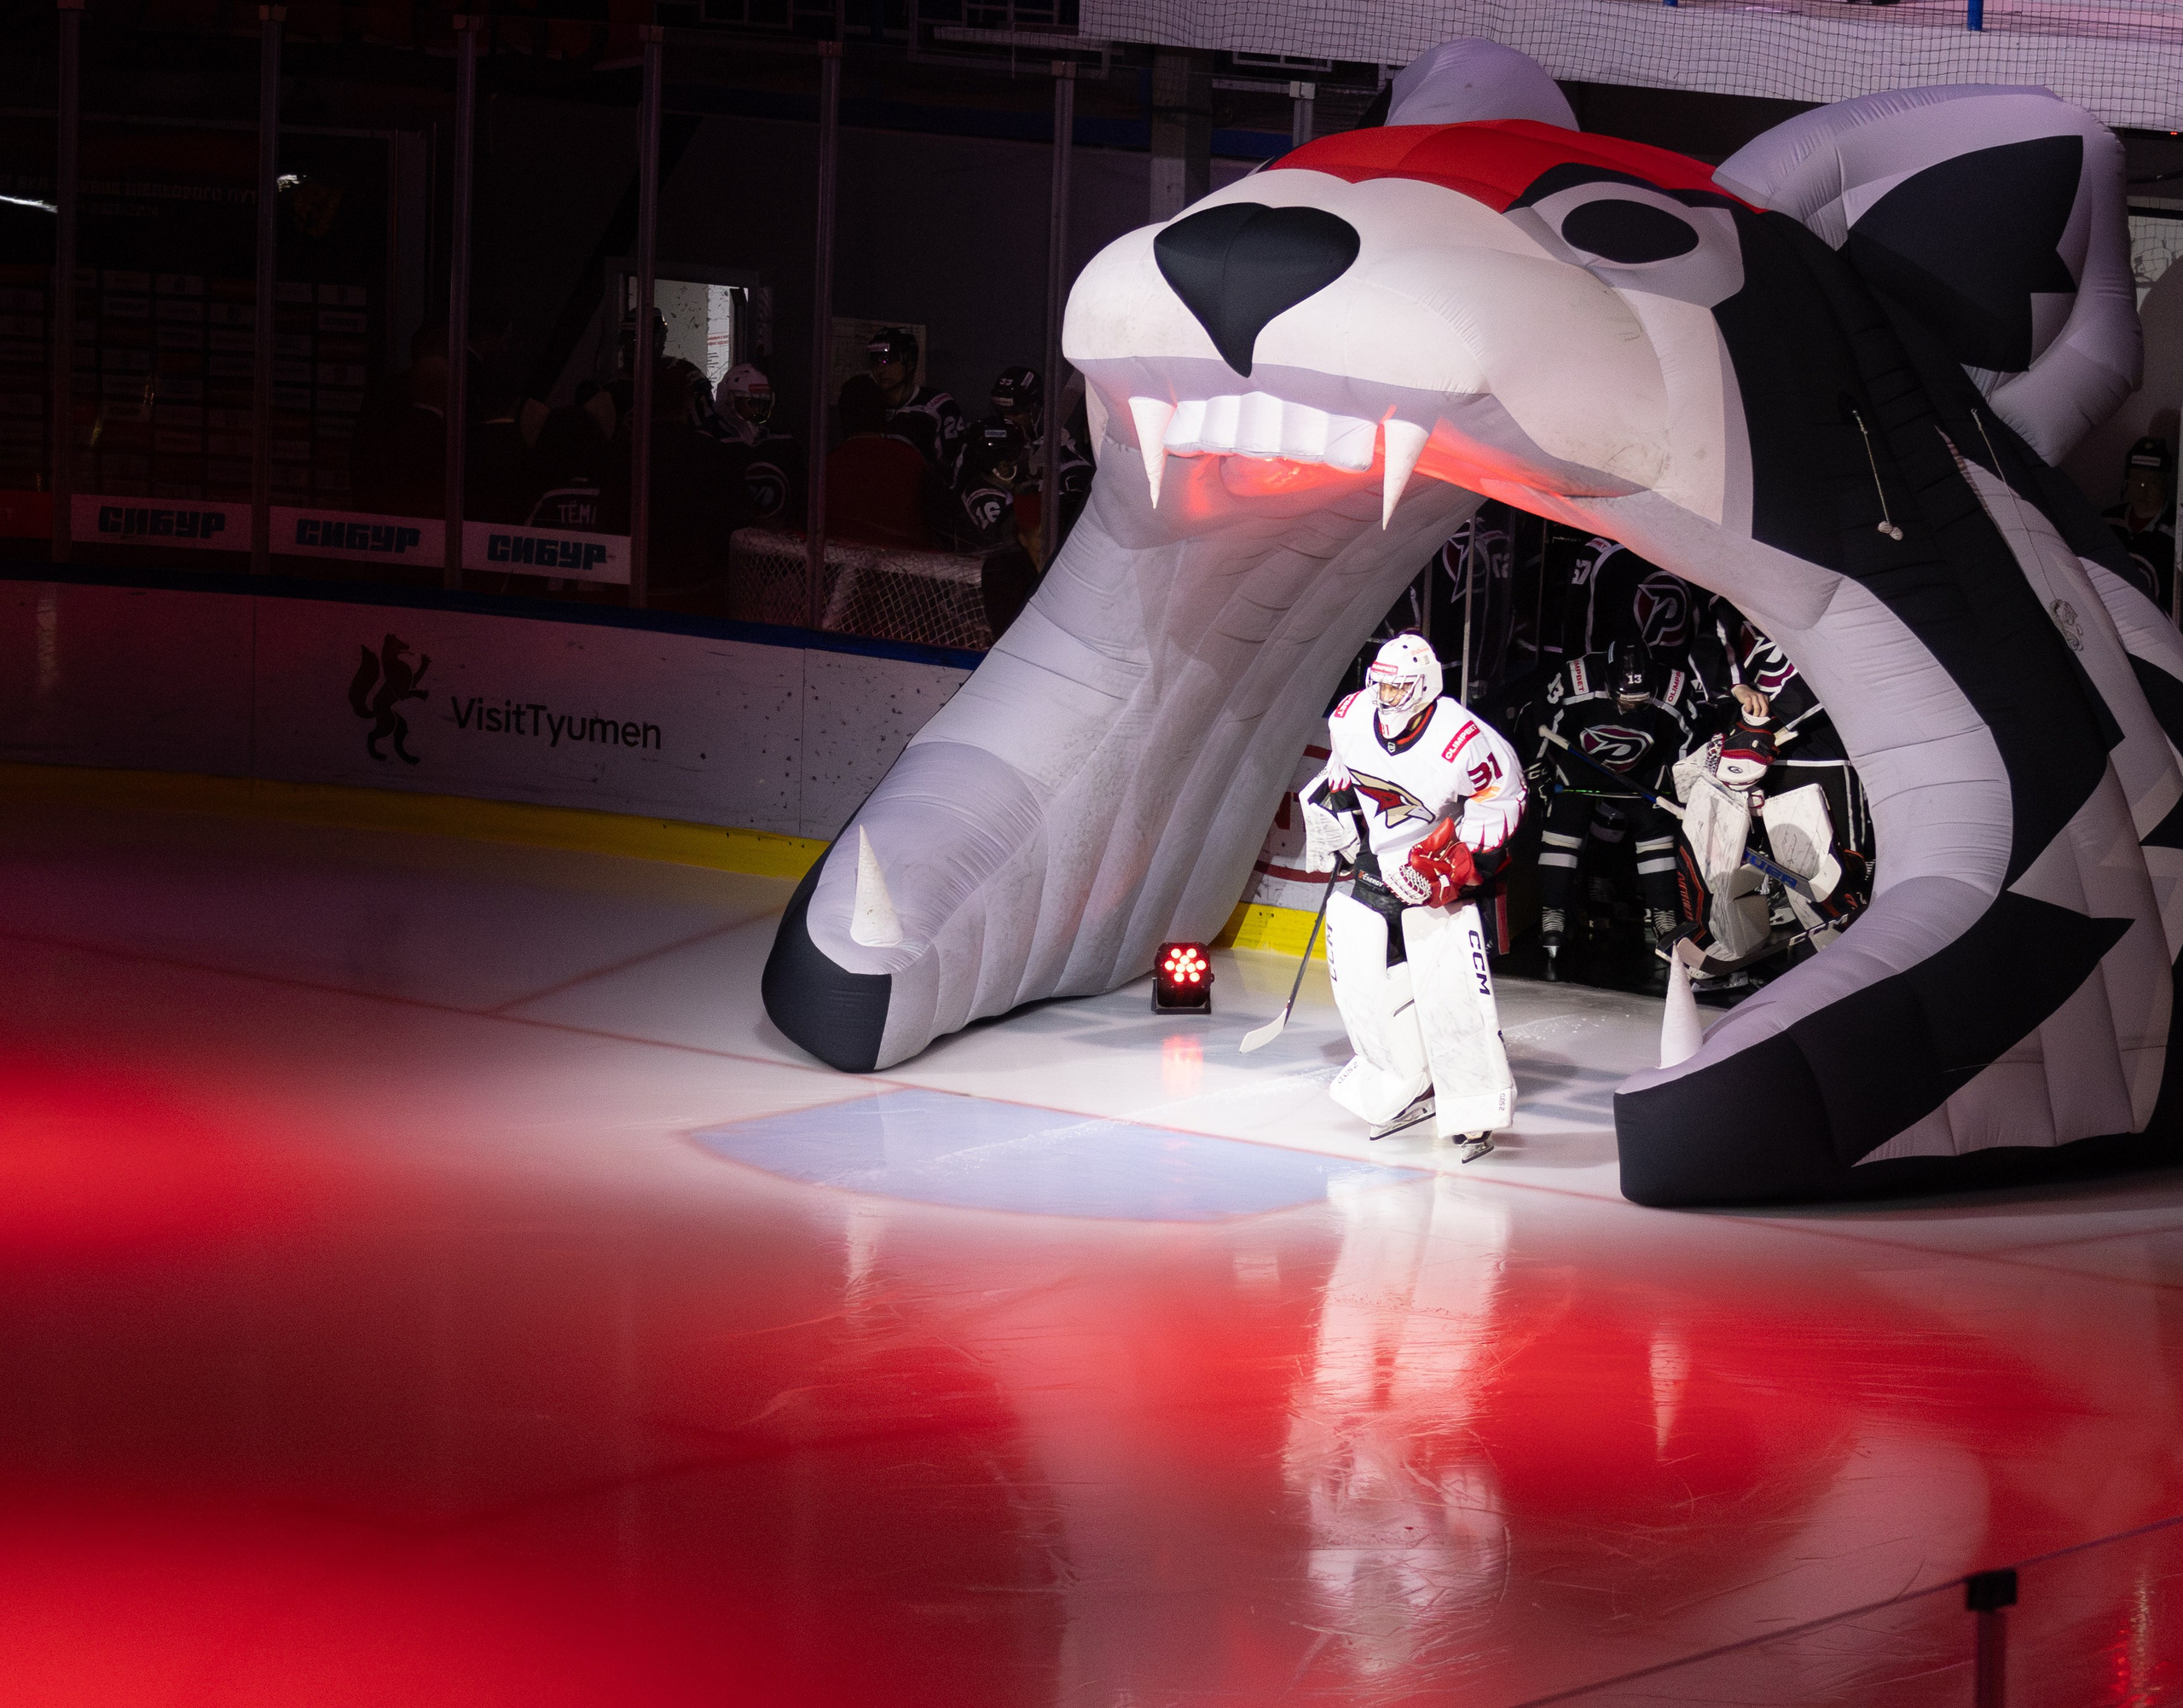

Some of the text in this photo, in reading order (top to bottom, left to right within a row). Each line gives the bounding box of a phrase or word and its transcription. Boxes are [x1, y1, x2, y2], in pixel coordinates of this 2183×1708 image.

[99, 506, 225, 539] СИБУР
[296, 518, 420, 553] СИБУР
[488, 534, 607, 570] СИБУР
[1626, 674, 1643, 685] 13
[451, 695, 662, 750] VisitTyumen
[1444, 723, 1478, 760] OLIMPBET
[1467, 751, 1503, 792] 31
[1468, 929, 1491, 996] CCM
